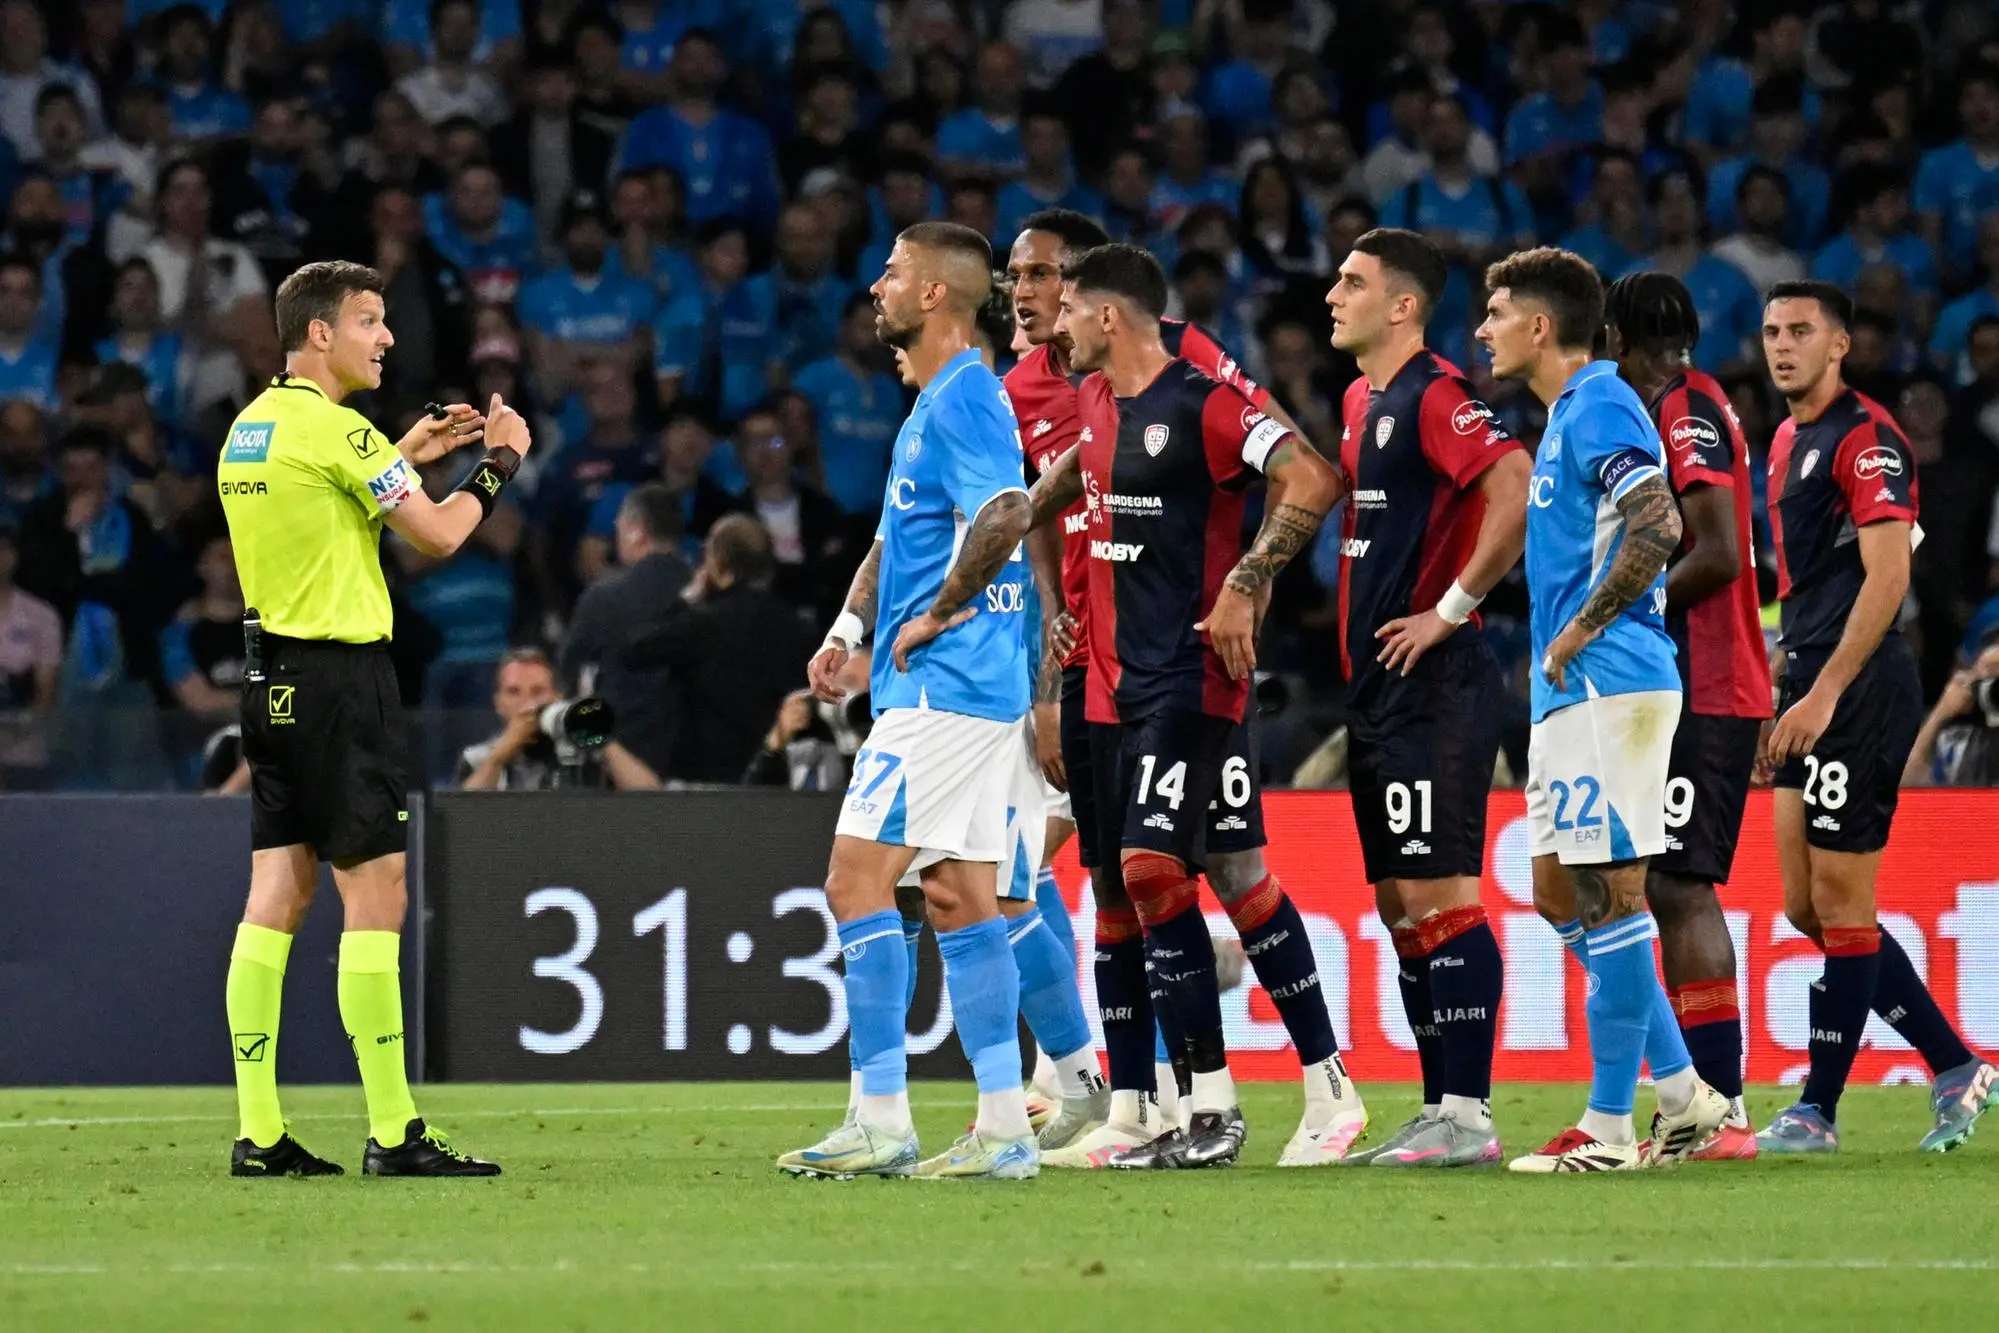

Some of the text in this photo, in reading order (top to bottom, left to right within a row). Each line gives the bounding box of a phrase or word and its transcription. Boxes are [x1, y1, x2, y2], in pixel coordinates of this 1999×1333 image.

[1671, 425, 1716, 443] Arborea
[221, 481, 268, 496] GIVOVA
[368, 459, 406, 497] NET
[1604, 456, 1636, 490] PEACE
[1102, 494, 1163, 508] SARDEGNA
[1091, 540, 1144, 562] MOBY
[1137, 755, 1187, 811] 14
[1208, 755, 1251, 808] 6
[1802, 754, 1849, 810] 28
[851, 800, 878, 814] EA7
[1385, 780, 1431, 834] 91
[1549, 775, 1603, 831] 22
[1575, 829, 1601, 843] EA7
